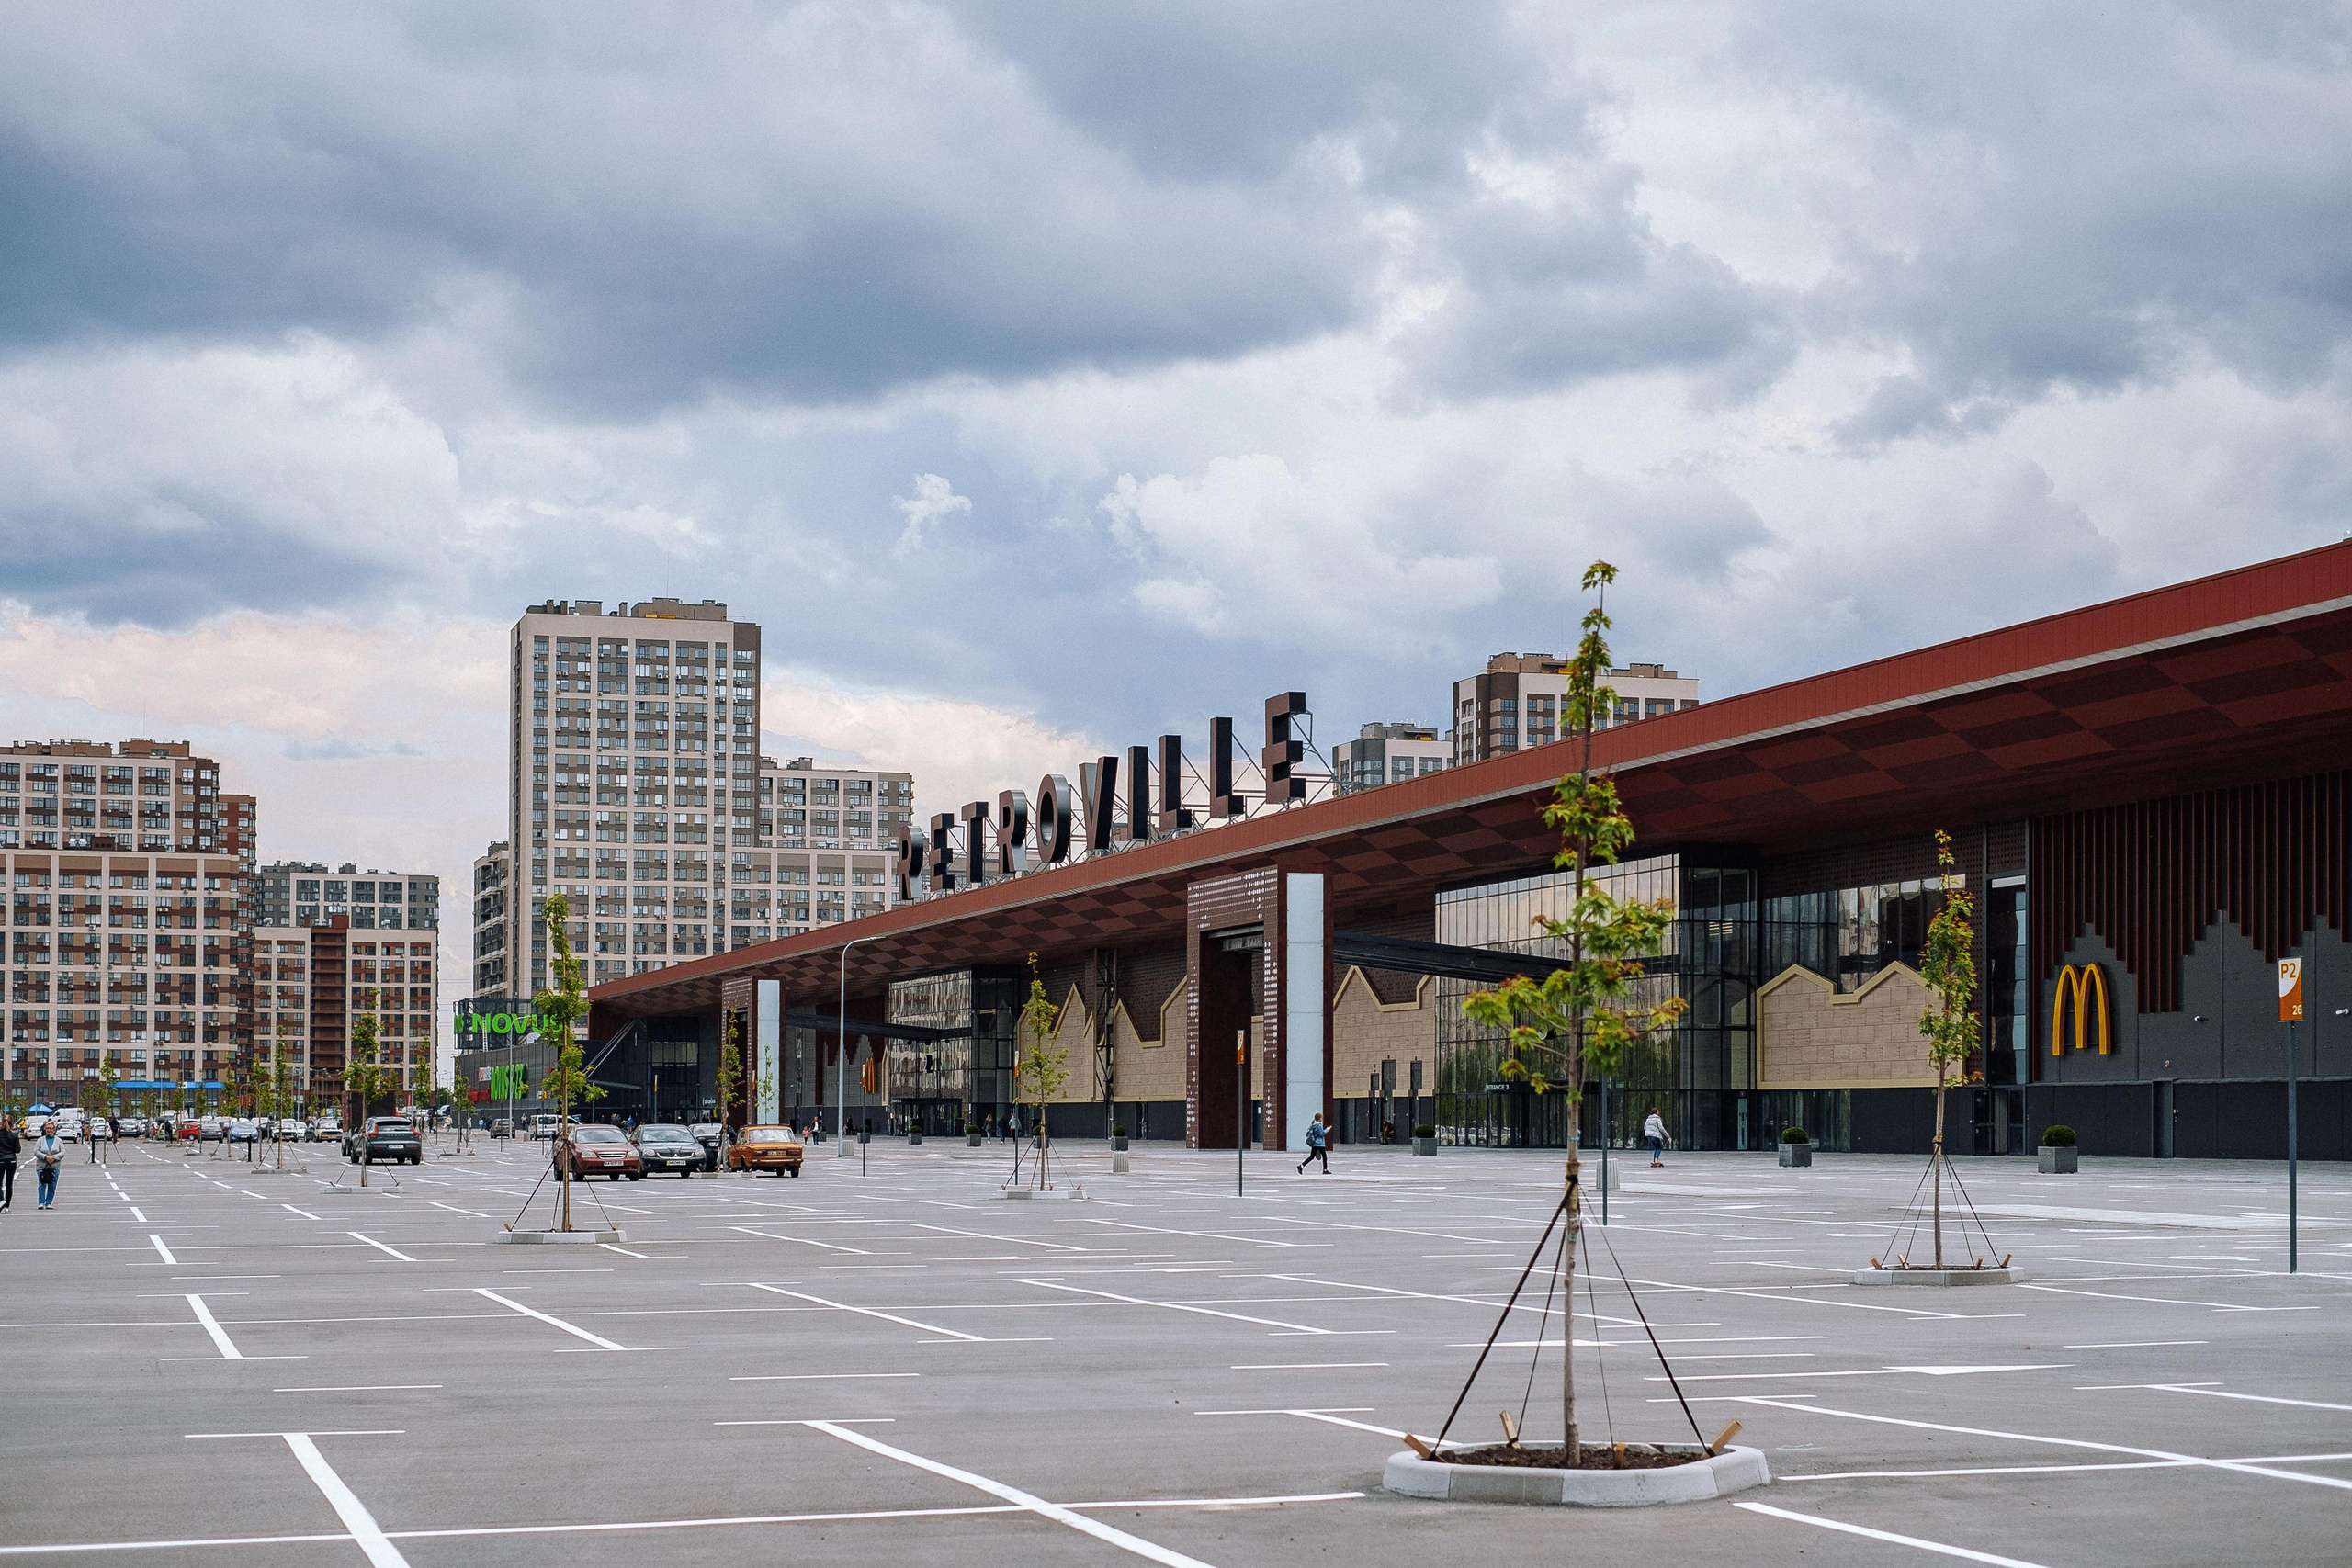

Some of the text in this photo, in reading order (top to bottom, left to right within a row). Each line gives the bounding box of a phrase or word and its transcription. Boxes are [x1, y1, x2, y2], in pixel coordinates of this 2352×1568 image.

[897, 691, 1306, 900] RETROVILLE
[2281, 963, 2297, 979] P2
[2292, 1005, 2302, 1015] 26
